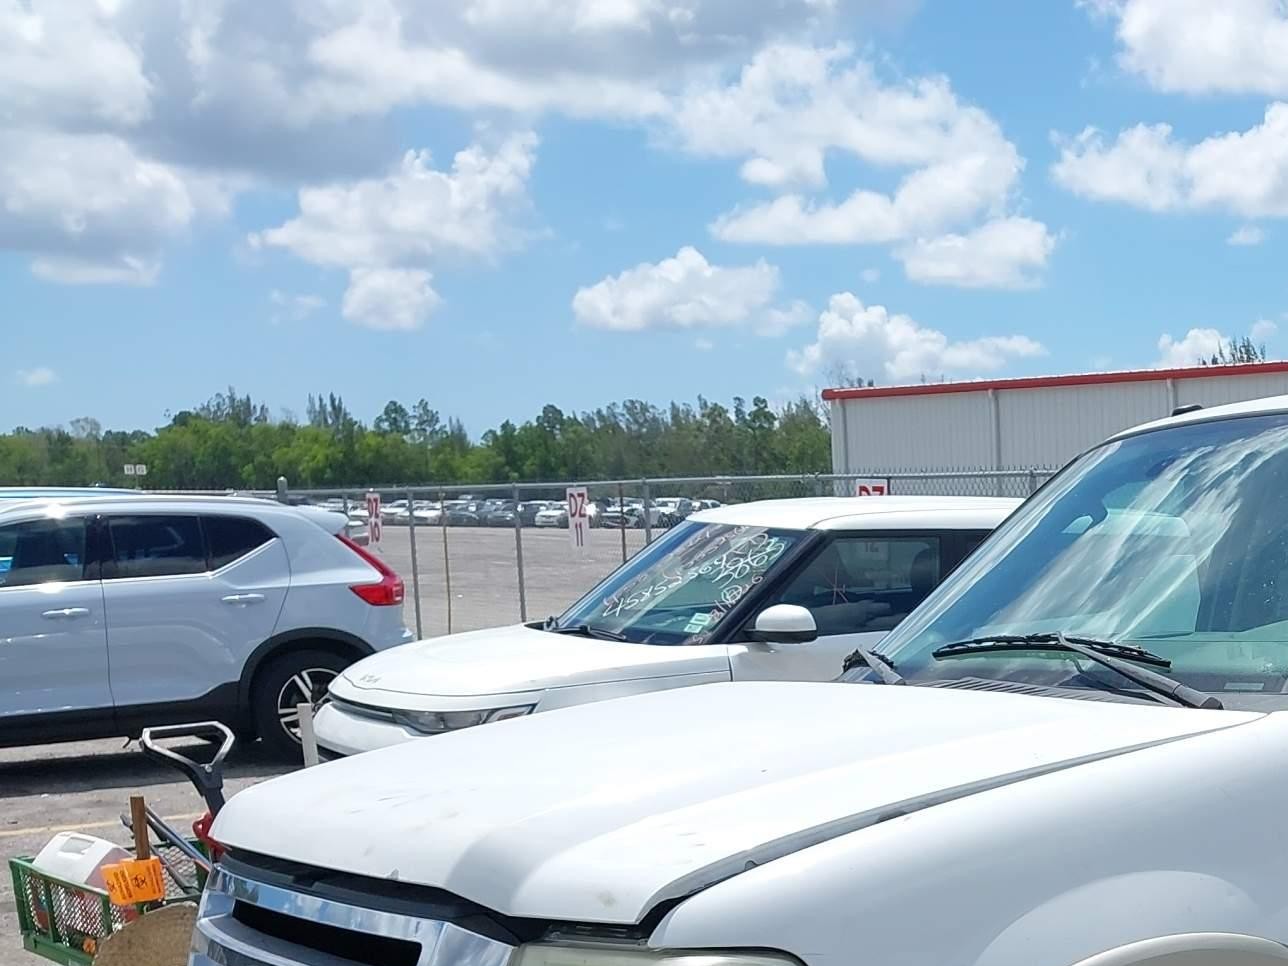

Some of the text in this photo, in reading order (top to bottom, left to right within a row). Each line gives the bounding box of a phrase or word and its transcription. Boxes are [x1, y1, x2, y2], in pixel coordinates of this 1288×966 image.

[367, 497, 380, 519] DZ
[569, 492, 587, 518] DZ
[574, 522, 584, 547] 11
